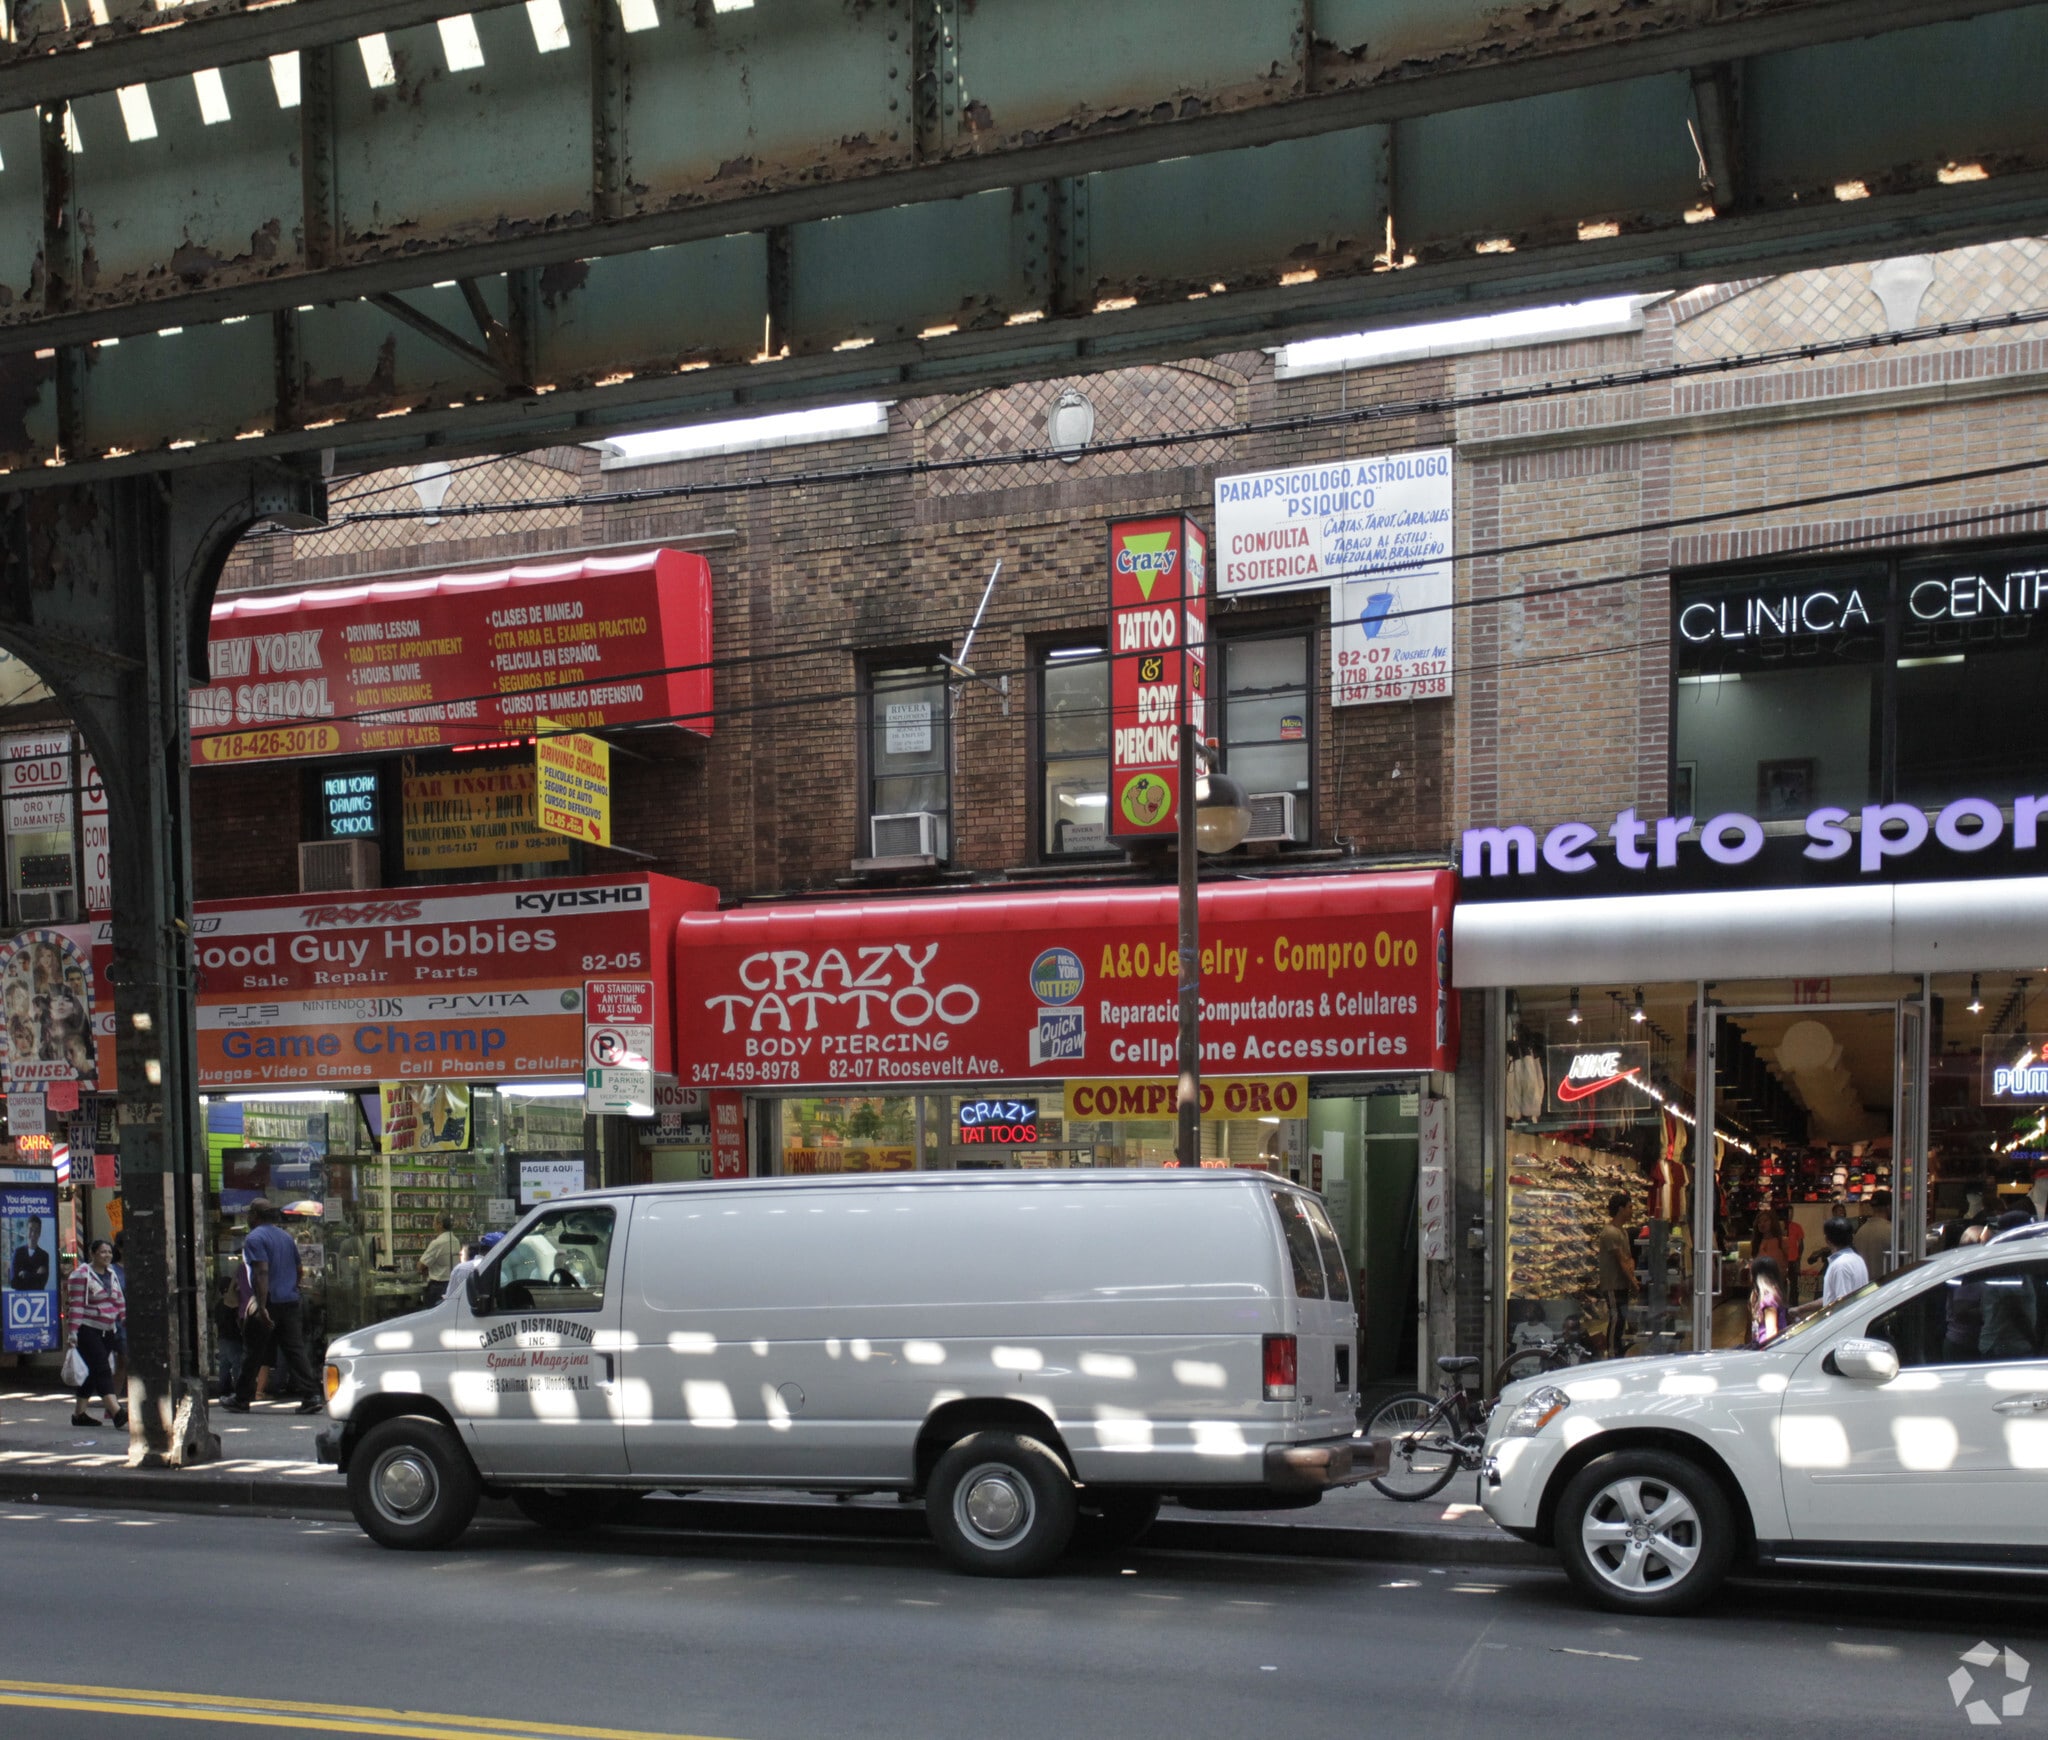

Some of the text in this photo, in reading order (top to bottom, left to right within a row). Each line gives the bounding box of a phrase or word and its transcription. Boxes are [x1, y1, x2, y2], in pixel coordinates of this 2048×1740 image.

[1357, 455, 1449, 486] ASTROLOGO,
[1232, 527, 1309, 555] CONSULTA
[1116, 548, 1177, 575] Crazy
[1227, 554, 1319, 583] ESOTERICA
[491, 601, 584, 628] CLASES DE MANEJO
[1680, 589, 1870, 641] CLINICA
[346, 619, 421, 642] DRIVING LESSON
[494, 616, 648, 649] CITA PARA EL EXAMEN PRACTICO
[1118, 608, 1175, 650] TATTOO
[254, 629, 324, 675] YORK
[350, 637, 463, 664] ROAD TEST APPOINTMENT
[495, 642, 602, 672] PELICULA EN ESPAÑOL
[351, 663, 422, 685] 5 HOURS MOVIE
[498, 668, 585, 693] SEGUROS DE AUTO
[1141, 658, 1162, 682] &
[235, 678, 335, 725] SCHOOL
[356, 683, 433, 706] AUTO INSURANCE
[501, 684, 644, 715] CURSO DE MANEJO DEFENSIVO
[1138, 684, 1178, 724] BODY
[408, 703, 446, 724] DRIVING
[447, 700, 478, 720] CURSE
[891, 704, 926, 714] RIVERA
[212, 729, 328, 758] 718-426-3018
[361, 726, 441, 748] SAME DAY PLATES
[573, 736, 594, 758] YORK
[1115, 724, 1178, 765] PIERCING
[14, 761, 62, 784] GOLD
[540, 743, 575, 770] DRIVING
[575, 756, 607, 782] SCHOOL
[348, 776, 375, 792] YORK
[403, 780, 442, 798] CAR
[544, 766, 574, 785] PELICULAS
[575, 776, 583, 787] EN
[544, 780, 593, 804] SEGURO DE AUTO
[23, 801, 53, 813] ORO Y
[329, 795, 372, 815] DRIVING
[406, 802, 419, 825] LA
[423, 799, 472, 825] PELICULA
[496, 795, 523, 819] HOUR
[544, 793, 567, 809] CURSOS
[567, 800, 602, 820] DEFENSIVOS
[13, 812, 66, 827] DIAMANTES
[331, 816, 375, 835] SCHOOL
[1460, 807, 1765, 878] metro
[290, 924, 558, 968] Guy Hobbies
[1100, 931, 1418, 983] A&O Jeelry Compro Oro
[243, 952, 642, 988] Sale Repair Parts 82-05
[739, 942, 939, 991] CRAZY
[1058, 954, 1075, 966] NEW
[1058, 965, 1080, 979] YORK
[593, 984, 646, 994] NO STANDING
[601, 994, 637, 1004] ANYTIME
[1035, 980, 1080, 998] LOTTERY
[218, 997, 403, 1019] PS3 NINTENDO 3DS
[597, 1004, 643, 1014] TAXI STAND
[705, 984, 980, 1034] TATTOO
[1198, 990, 1417, 1026] Computadoras & Celulares
[1041, 1014, 1076, 1043] Quick
[222, 1024, 508, 1060] Game Champ
[745, 1032, 950, 1057] BODY PIERCING
[1051, 1031, 1086, 1060] Draw
[1243, 1031, 1408, 1059] Accessories
[14, 1064, 73, 1078] UNISEX
[316, 1056, 507, 1076] Games Cell Phones
[692, 1055, 1004, 1082] 347-459-8978 82-07 Roosevelt Ave.
[1568, 1051, 1622, 1080] NIKE
[608, 1076, 645, 1084] PARKING
[1994, 1067, 2048, 1095] PUM
[1072, 1081, 1298, 1116] COMPO ORO
[661, 1113, 681, 1127] 82-05
[960, 1101, 1036, 1125] CRAZY
[521, 1165, 550, 1173] PAGUE
[787, 1150, 842, 1174] PHONECARD
[13, 1169, 41, 1182] TITAN
[5, 1194, 48, 1205] You deserve
[7, 1205, 27, 1215] great
[12, 1297, 46, 1324] OZ
[479, 1317, 596, 1349] CASHOY DISTRIBUTION
[528, 1336, 549, 1346] INC.
[486, 1350, 589, 1372] Spanish Magazines
